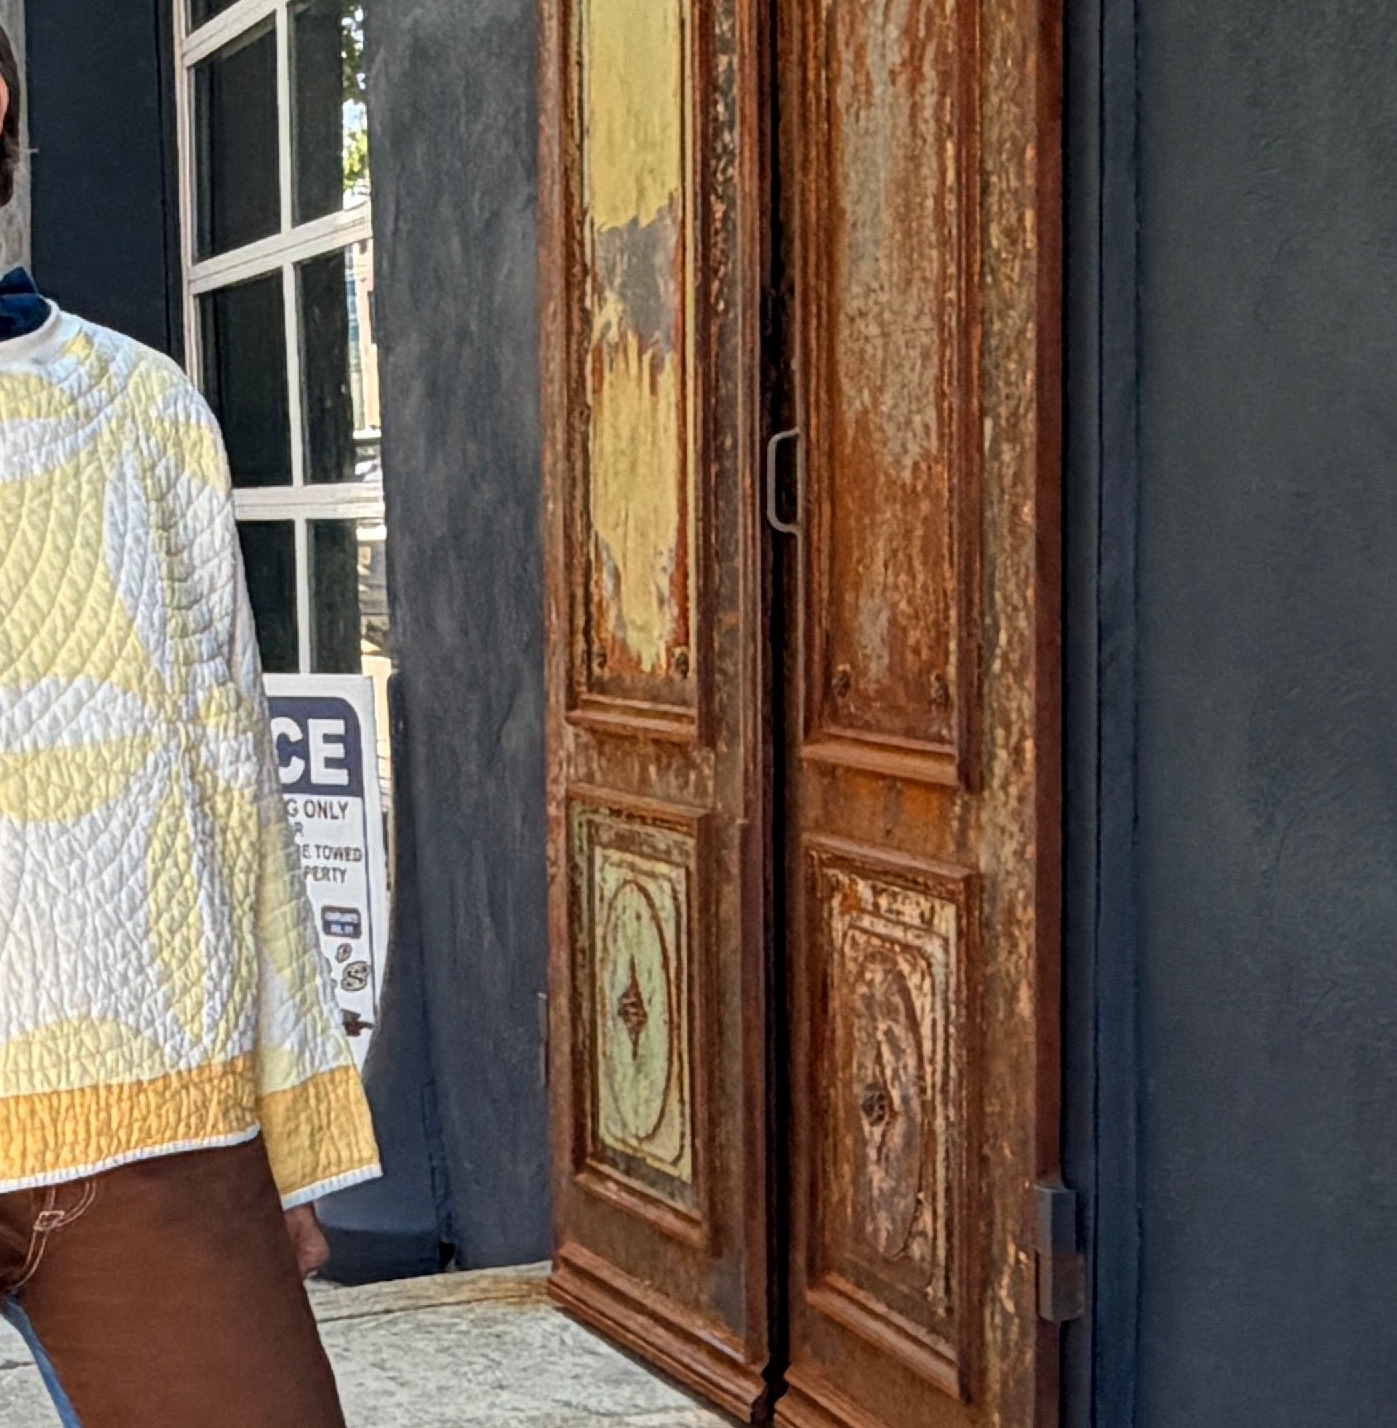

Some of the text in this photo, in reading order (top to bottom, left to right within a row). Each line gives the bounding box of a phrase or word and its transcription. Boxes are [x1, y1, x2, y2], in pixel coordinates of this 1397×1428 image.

[272, 717, 349, 785] CE
[287, 798, 349, 820] G ONLY
[302, 844, 363, 862] E TOWED
[303, 864, 347, 884] PERTY
